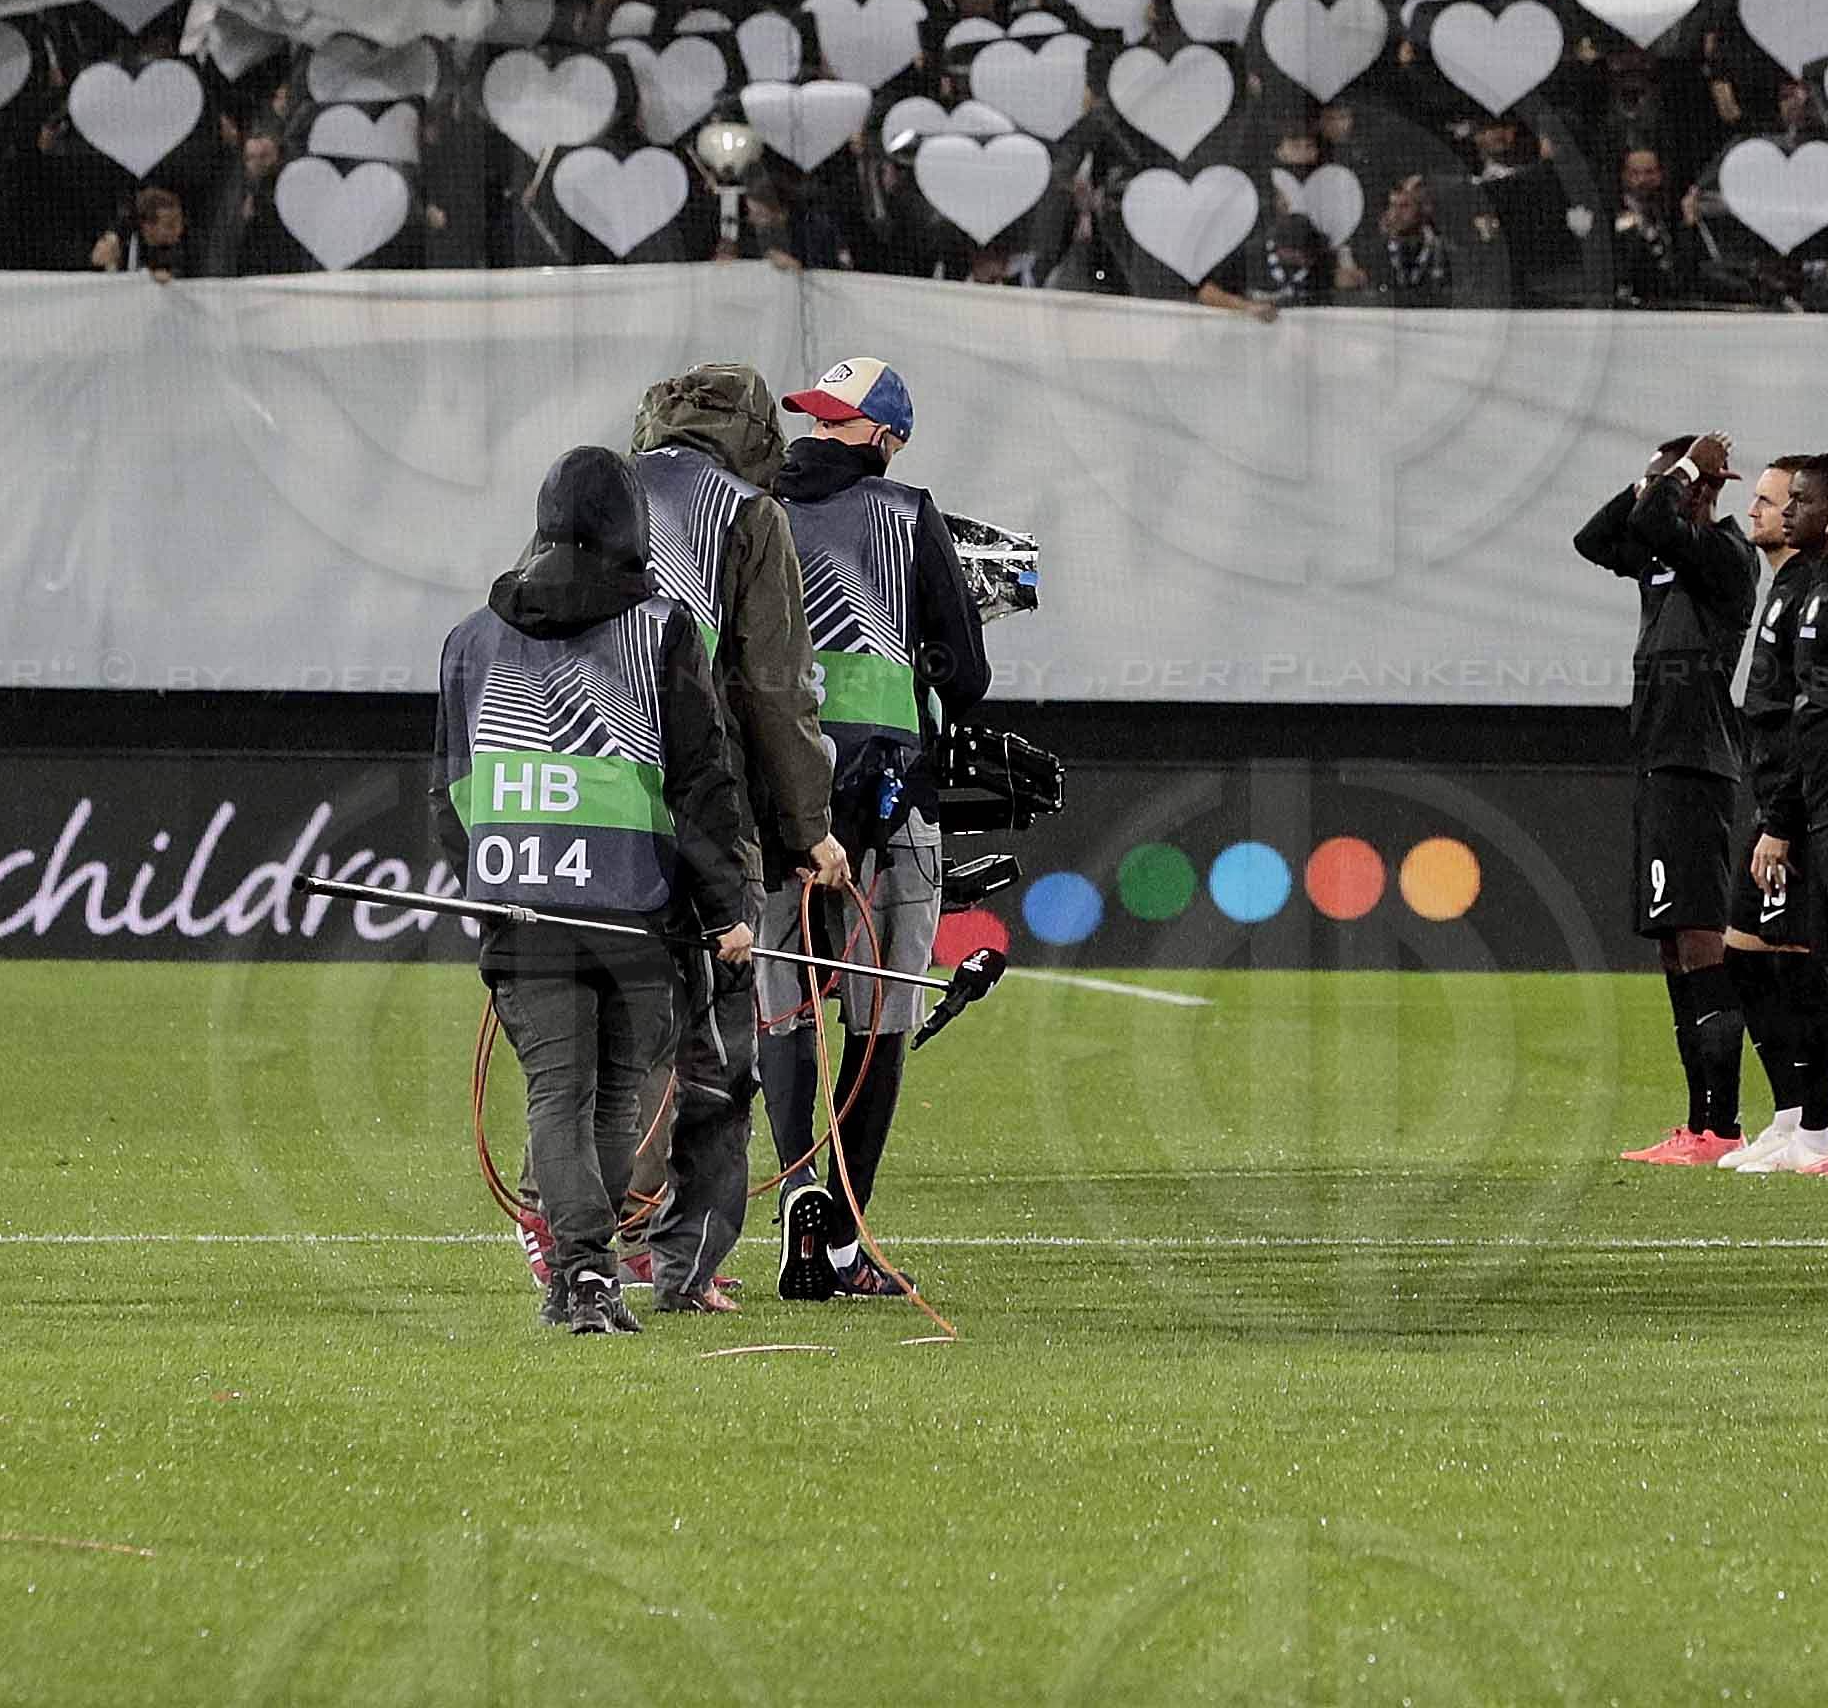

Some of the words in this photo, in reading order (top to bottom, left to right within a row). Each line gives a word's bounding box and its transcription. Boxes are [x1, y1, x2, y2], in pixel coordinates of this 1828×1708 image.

[491, 762, 580, 813] HB
[476, 835, 592, 887] 014
[1650, 859, 1666, 903] 9
